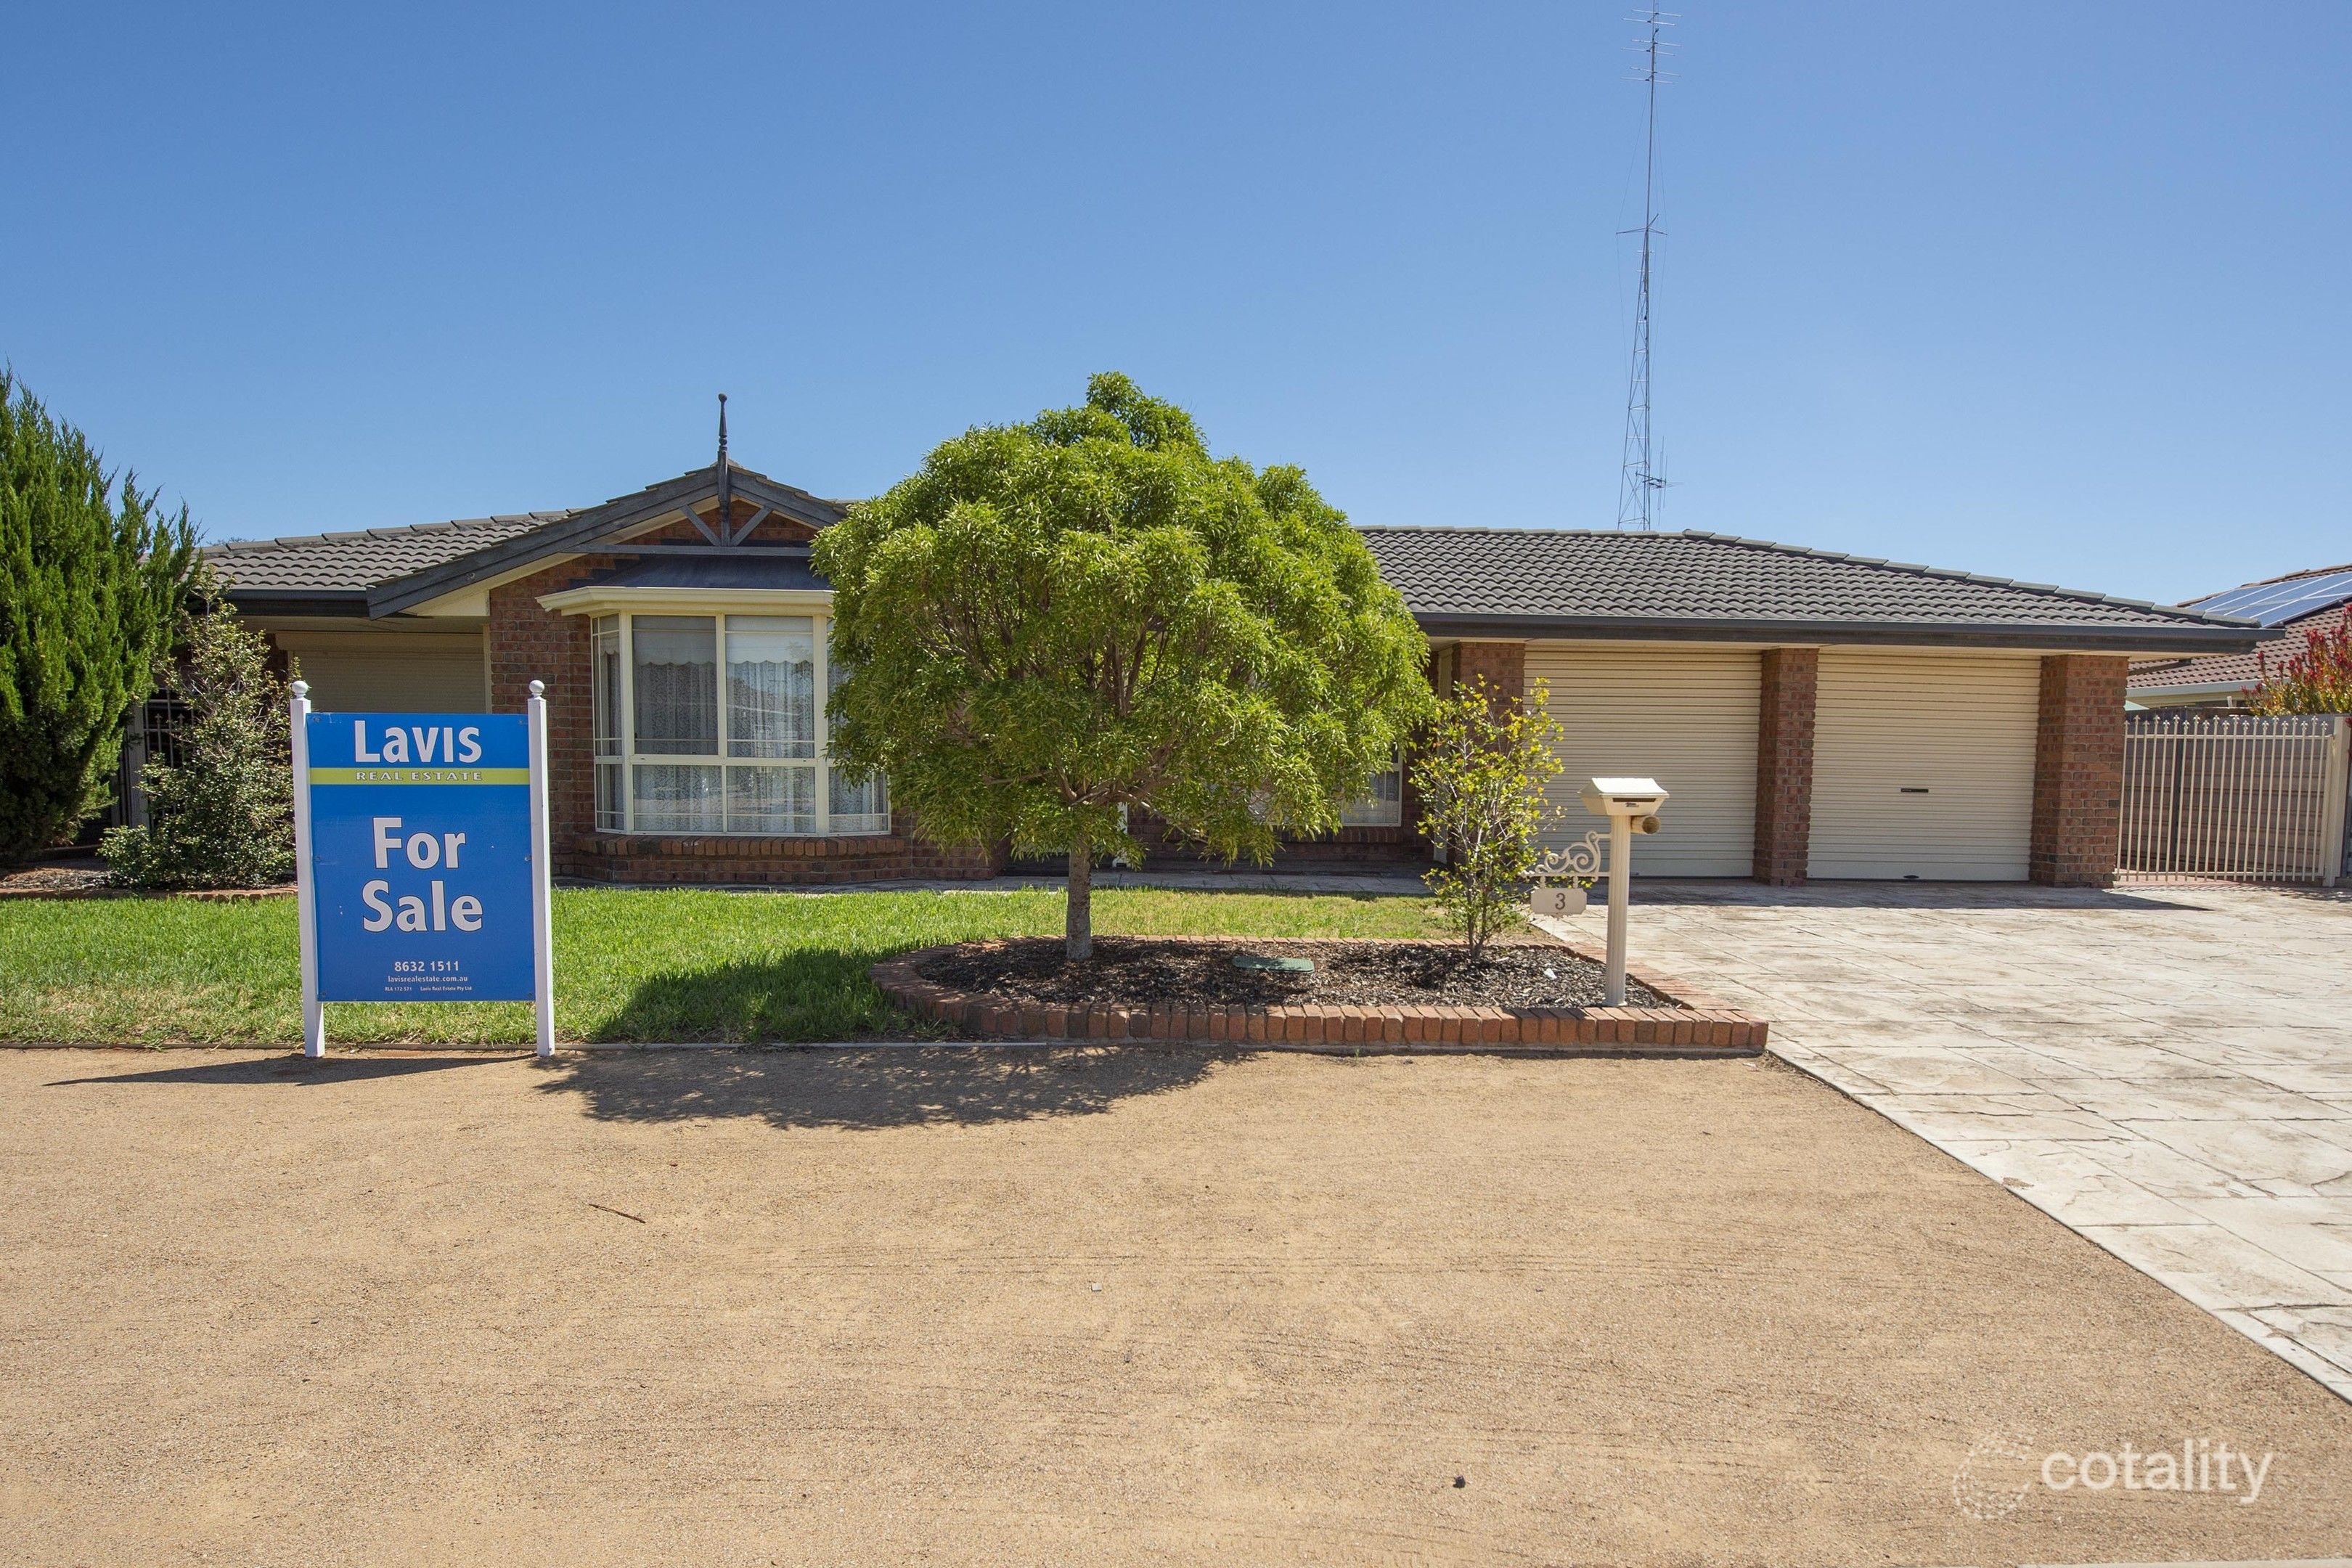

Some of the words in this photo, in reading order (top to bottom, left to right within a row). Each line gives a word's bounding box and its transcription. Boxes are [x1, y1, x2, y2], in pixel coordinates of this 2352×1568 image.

[354, 719, 482, 764] Lavis
[356, 771, 404, 781] REAL
[410, 771, 483, 781] ESTATE
[372, 816, 467, 870] For
[362, 879, 483, 933] Sale
[1555, 893, 1566, 910] 3
[394, 960, 425, 972] 8632
[430, 960, 459, 972] 1511
